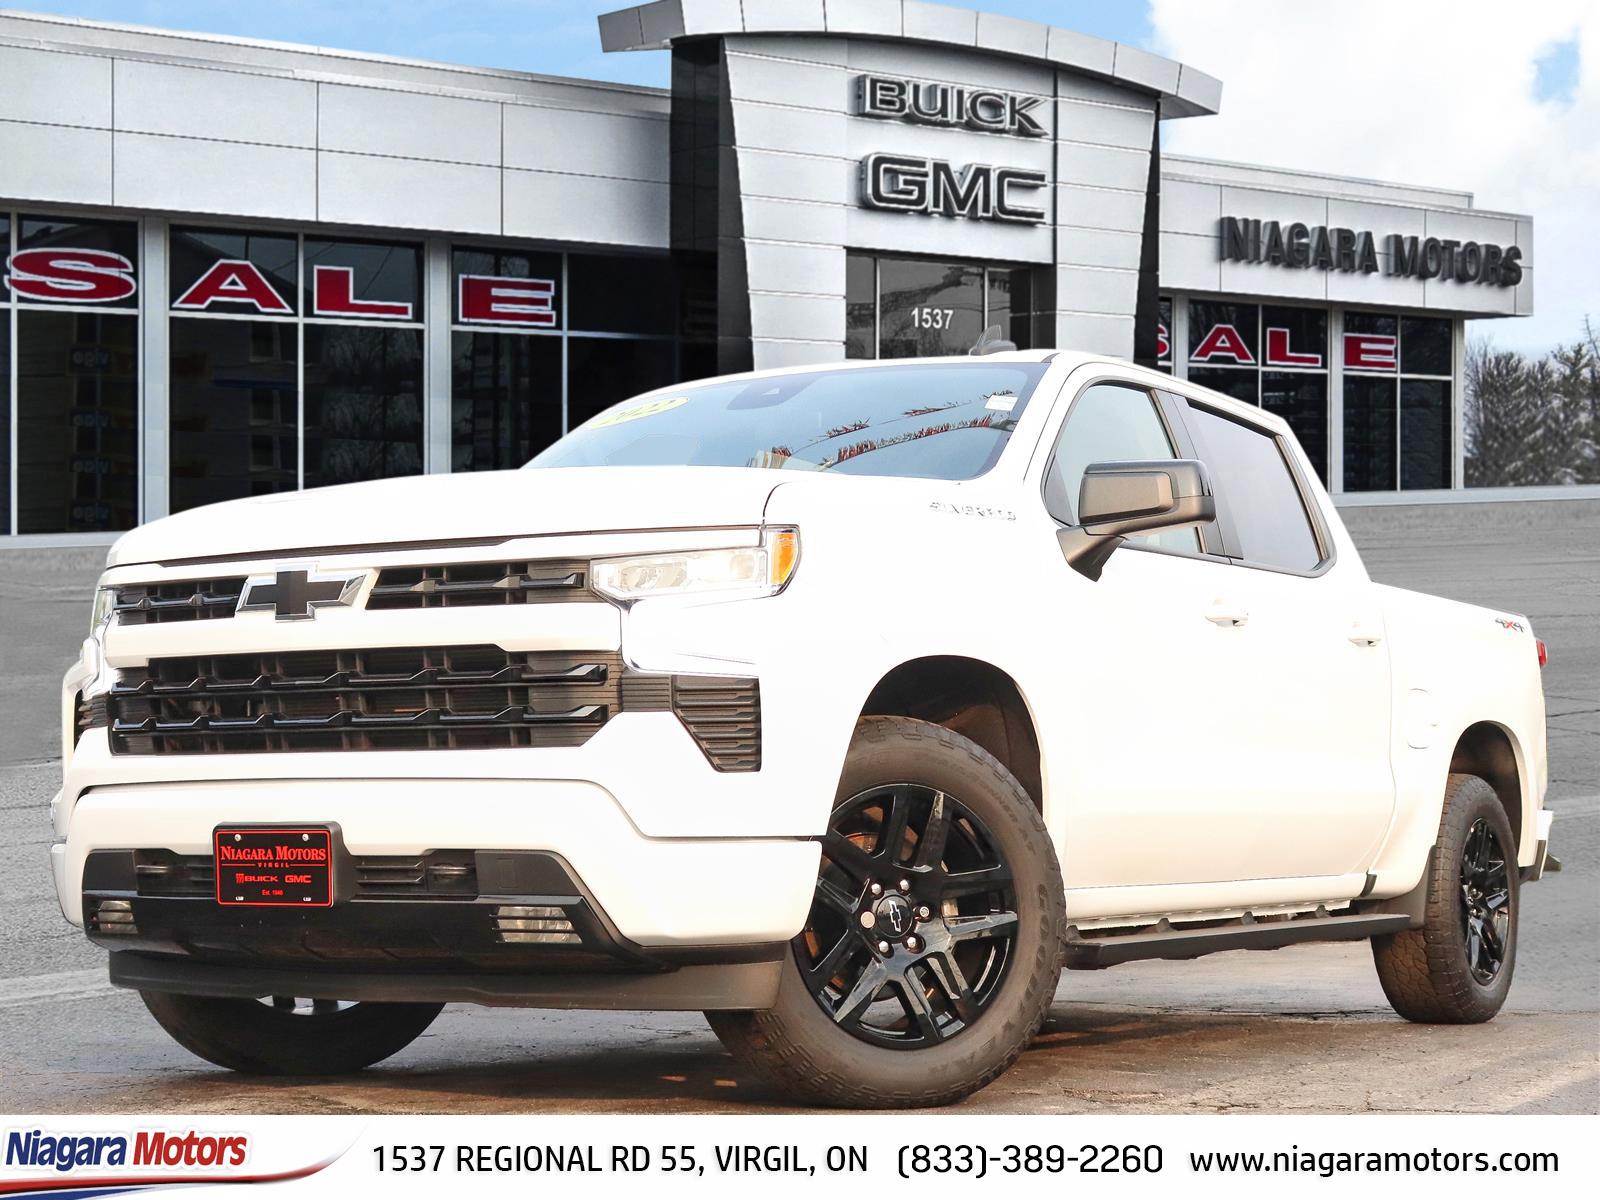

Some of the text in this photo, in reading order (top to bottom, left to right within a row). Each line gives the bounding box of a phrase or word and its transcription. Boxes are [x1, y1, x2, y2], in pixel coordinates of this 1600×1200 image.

[859, 75, 1048, 137] BUICK
[860, 152, 1048, 224] GMC
[1219, 216, 1523, 287] NIAGARA MOTORS
[4, 247, 556, 327] SALE
[911, 306, 954, 330] 1537
[244, 874, 313, 884] BUICK GMC
